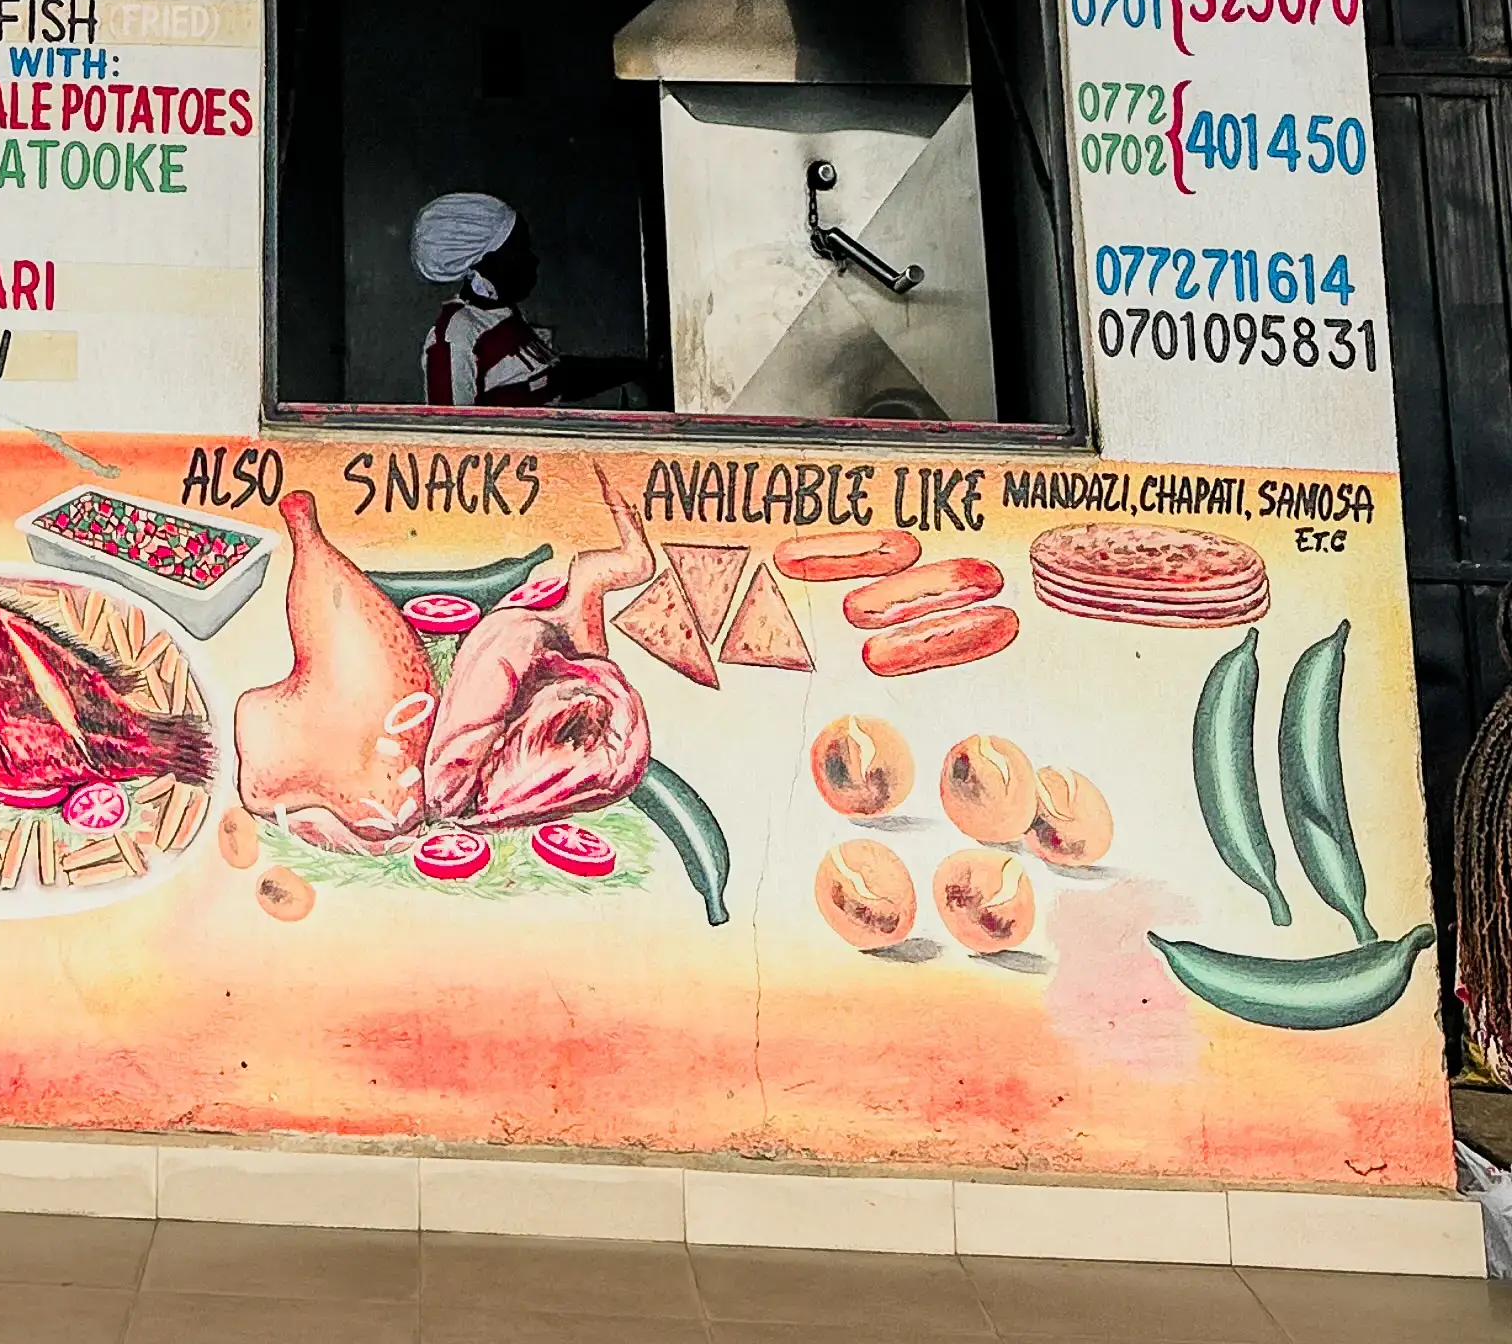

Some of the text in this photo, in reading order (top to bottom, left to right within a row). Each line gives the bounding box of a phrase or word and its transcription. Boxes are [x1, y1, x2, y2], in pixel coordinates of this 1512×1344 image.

[10, 47, 119, 80] WITH:
[62, 84, 253, 136] POTATOES
[1078, 82, 1167, 124] 0772
[1081, 133, 1167, 176] 0702
[1096, 245, 1355, 305] 0772711614
[1098, 308, 1376, 372] 0701095831
[182, 447, 284, 507] ALSO
[344, 452, 539, 515] SNACKS
[642, 459, 875, 526] AVAILABLE
[894, 467, 986, 532] LIKE
[1258, 480, 1374, 524] SAMOSA
